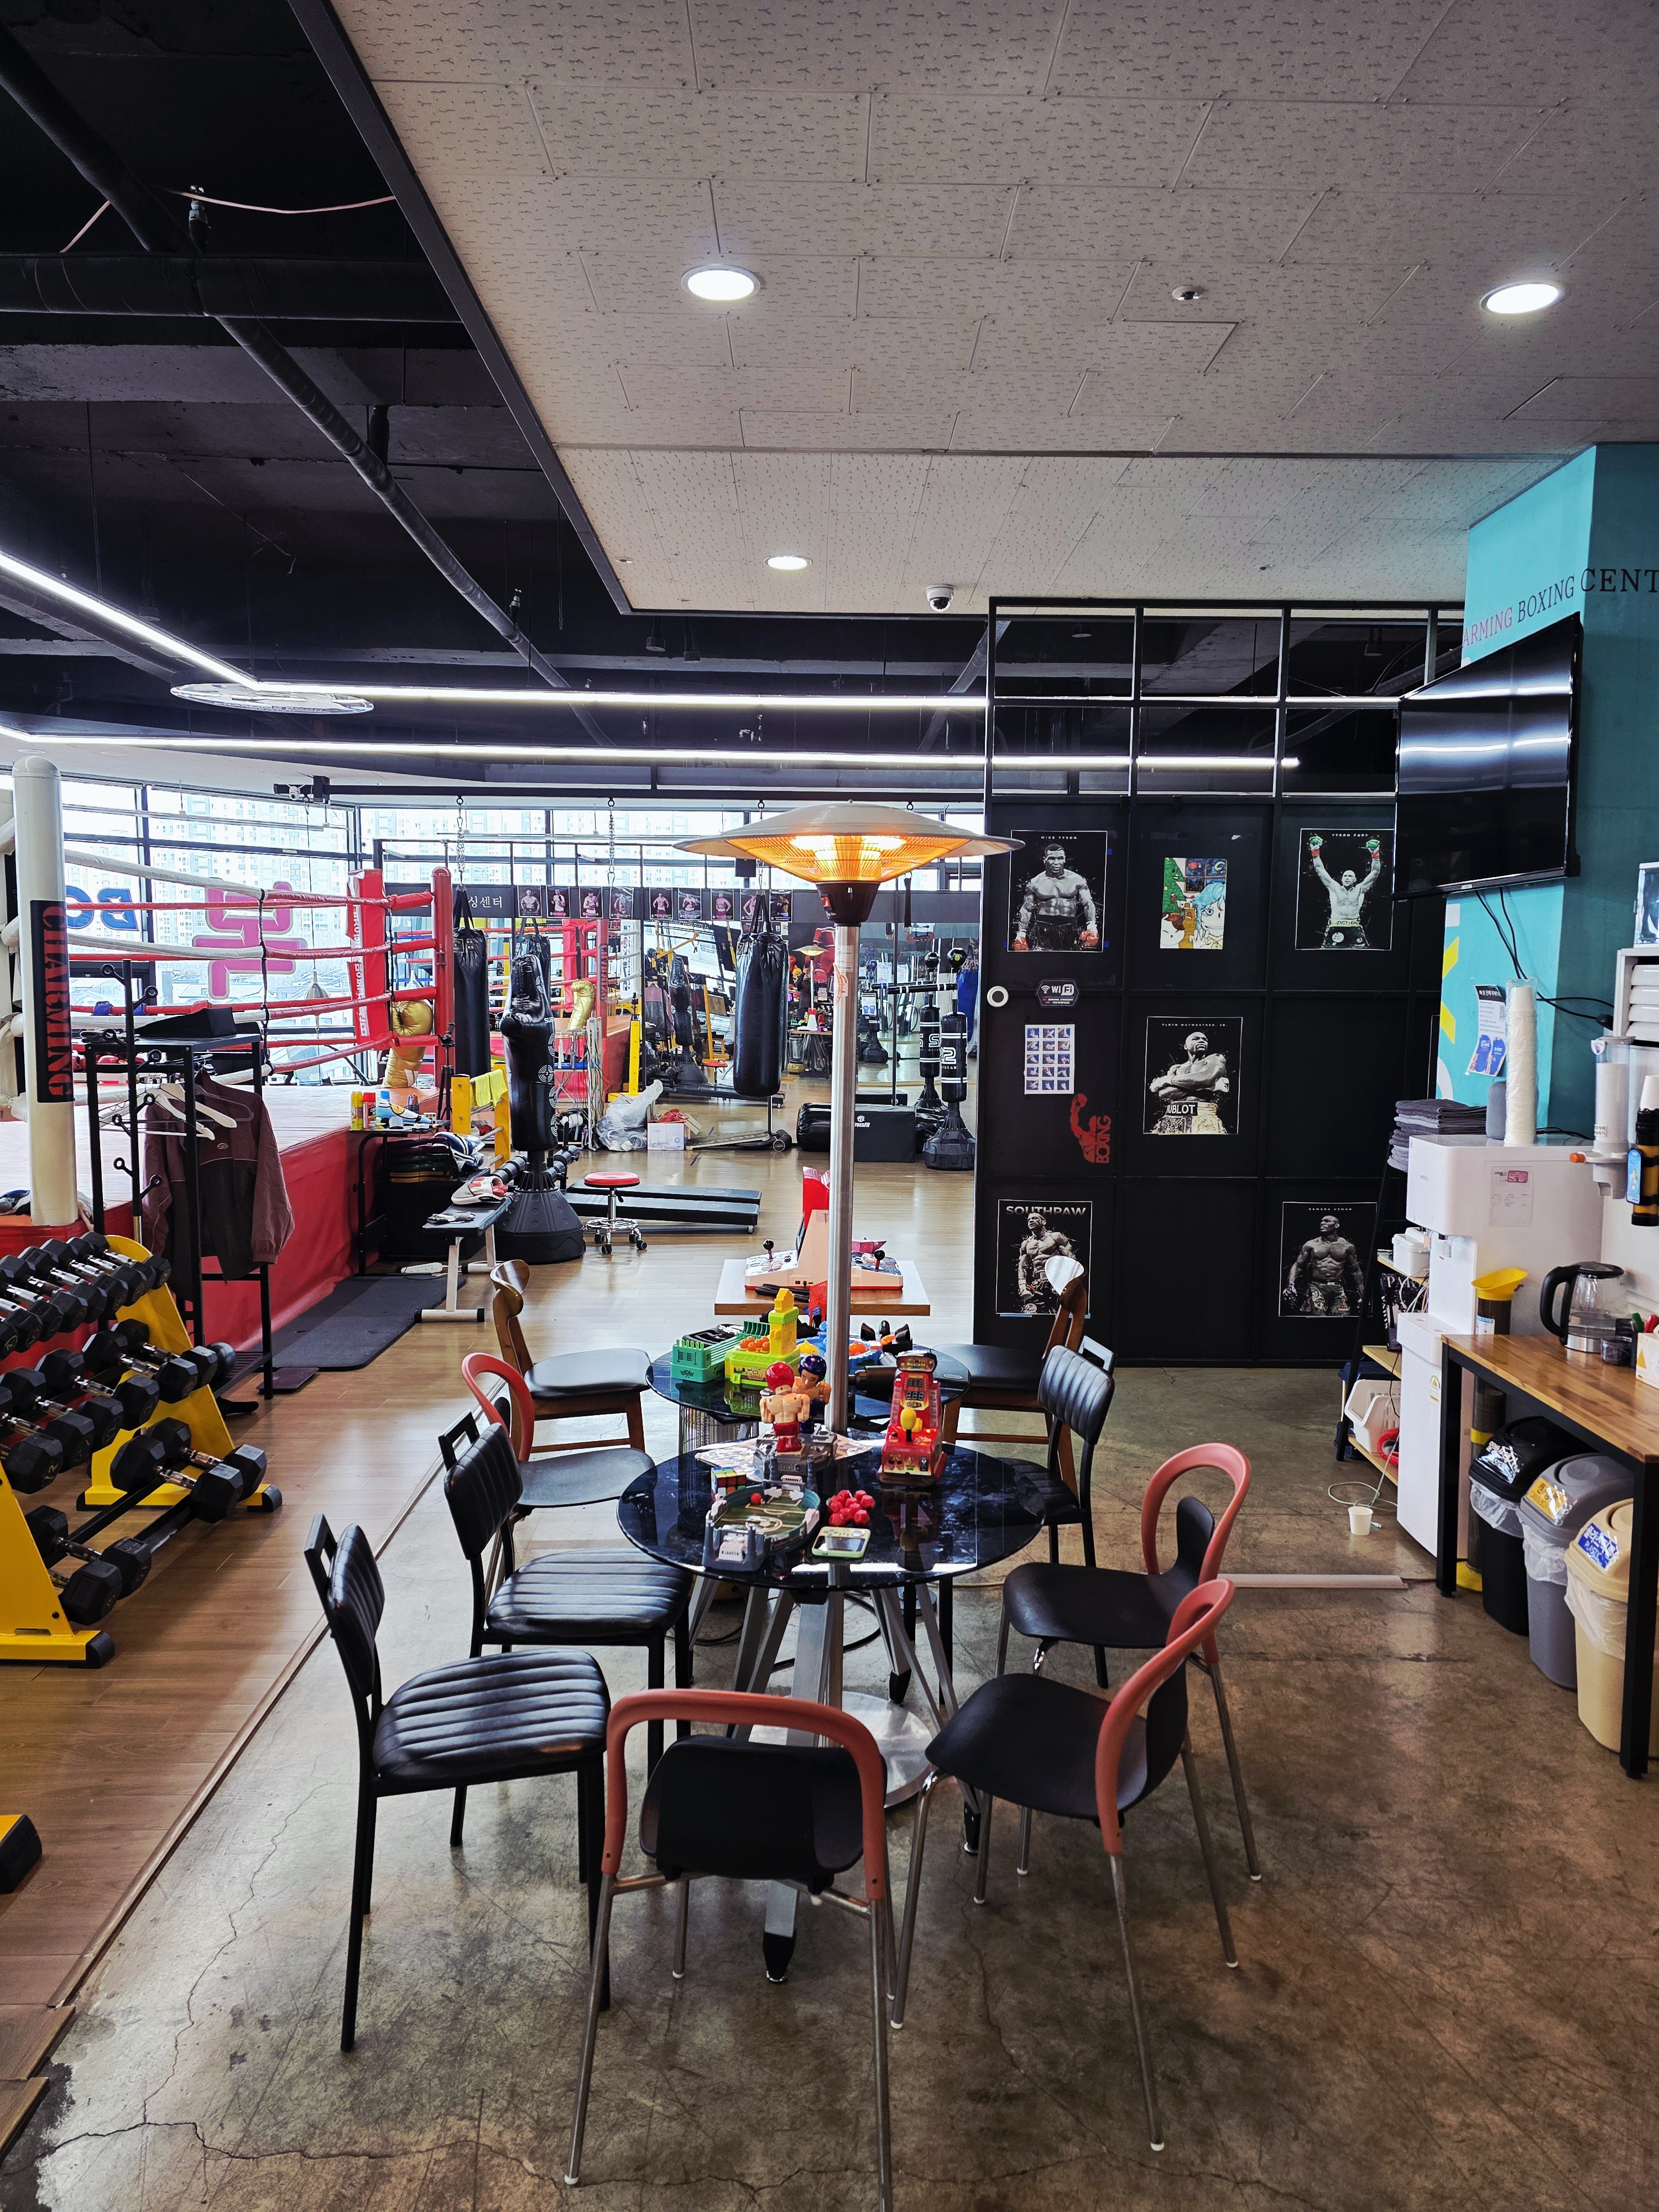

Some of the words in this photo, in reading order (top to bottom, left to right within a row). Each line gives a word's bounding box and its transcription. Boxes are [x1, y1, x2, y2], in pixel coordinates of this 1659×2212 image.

[1518, 575, 1575, 623] BOXING
[1580, 568, 1659, 593] CENT
[42, 906, 73, 1096] CHARMING
[1095, 1115, 1112, 1163] BOXING
[1006, 1206, 1086, 1216] SOUTHPAW
